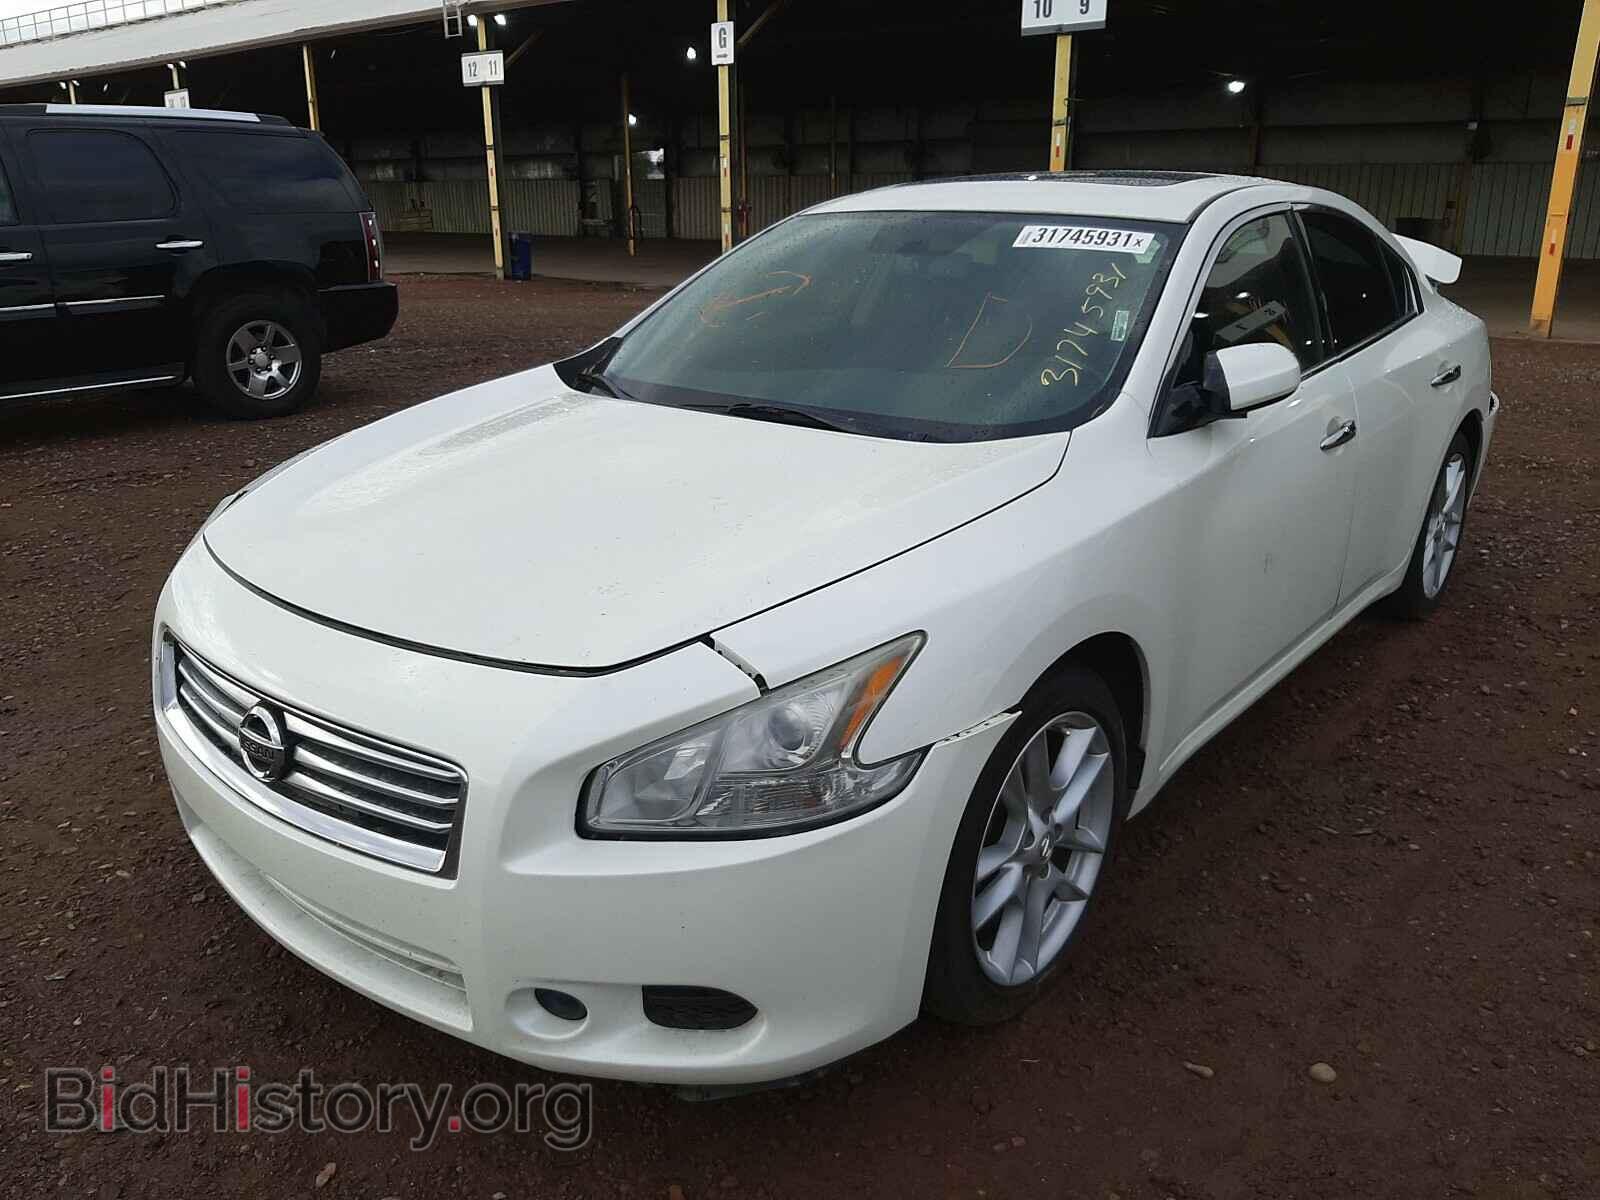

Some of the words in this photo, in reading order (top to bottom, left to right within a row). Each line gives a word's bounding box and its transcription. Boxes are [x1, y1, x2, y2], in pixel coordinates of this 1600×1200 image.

[1033, 0, 1053, 19] 10
[1080, 0, 1090, 15] 9
[719, 27, 727, 49] G
[468, 61, 478, 77] 12
[489, 60, 497, 76] 11
